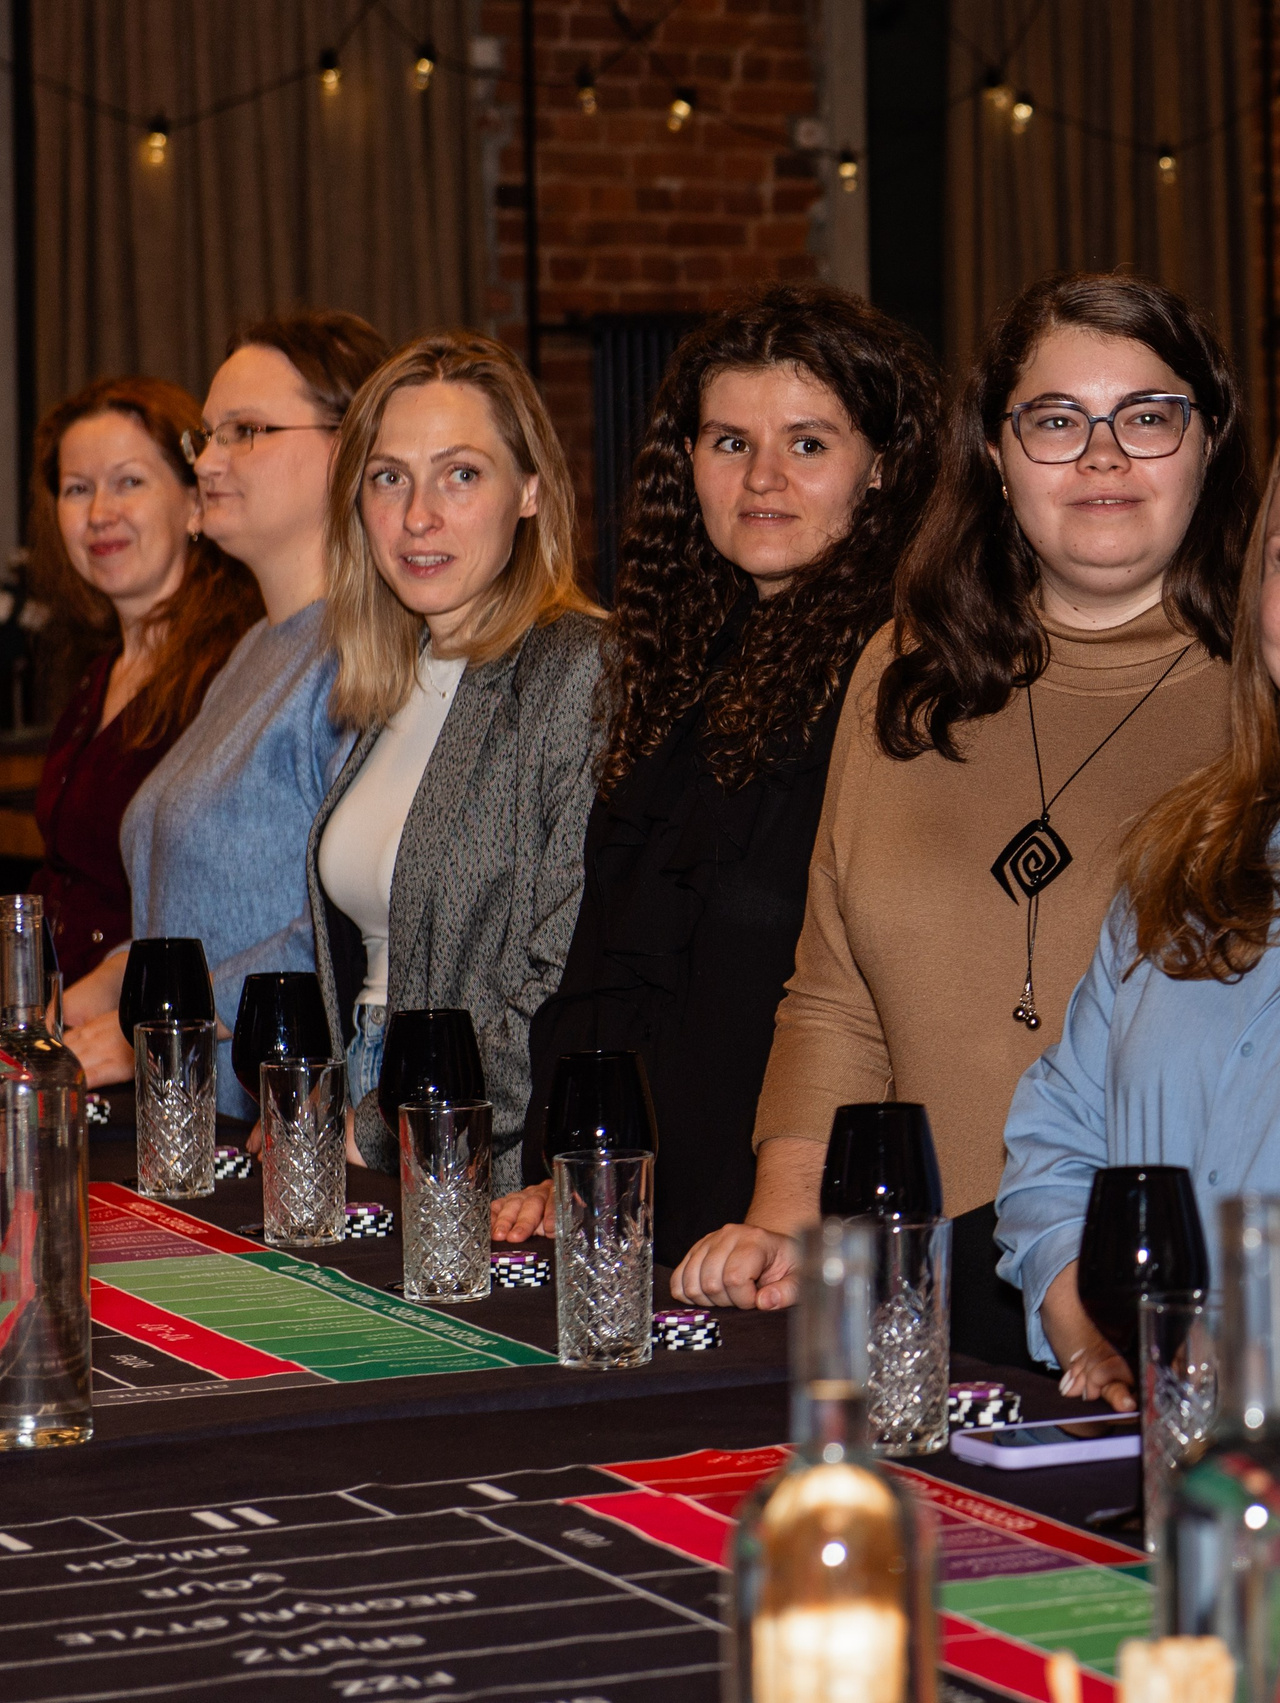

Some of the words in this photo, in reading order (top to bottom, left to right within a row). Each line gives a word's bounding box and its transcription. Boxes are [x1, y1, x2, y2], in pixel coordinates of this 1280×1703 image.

[108, 1390, 171, 1399] time
[180, 1383, 229, 1394] any
[65, 1544, 251, 1573] SMASH
[141, 1572, 287, 1599] SOUR
[239, 1590, 477, 1624] NEGRONI
[56, 1616, 230, 1645] STYLE
[232, 1633, 427, 1665] SPRITZ
[332, 1670, 456, 1697] FIZZ
